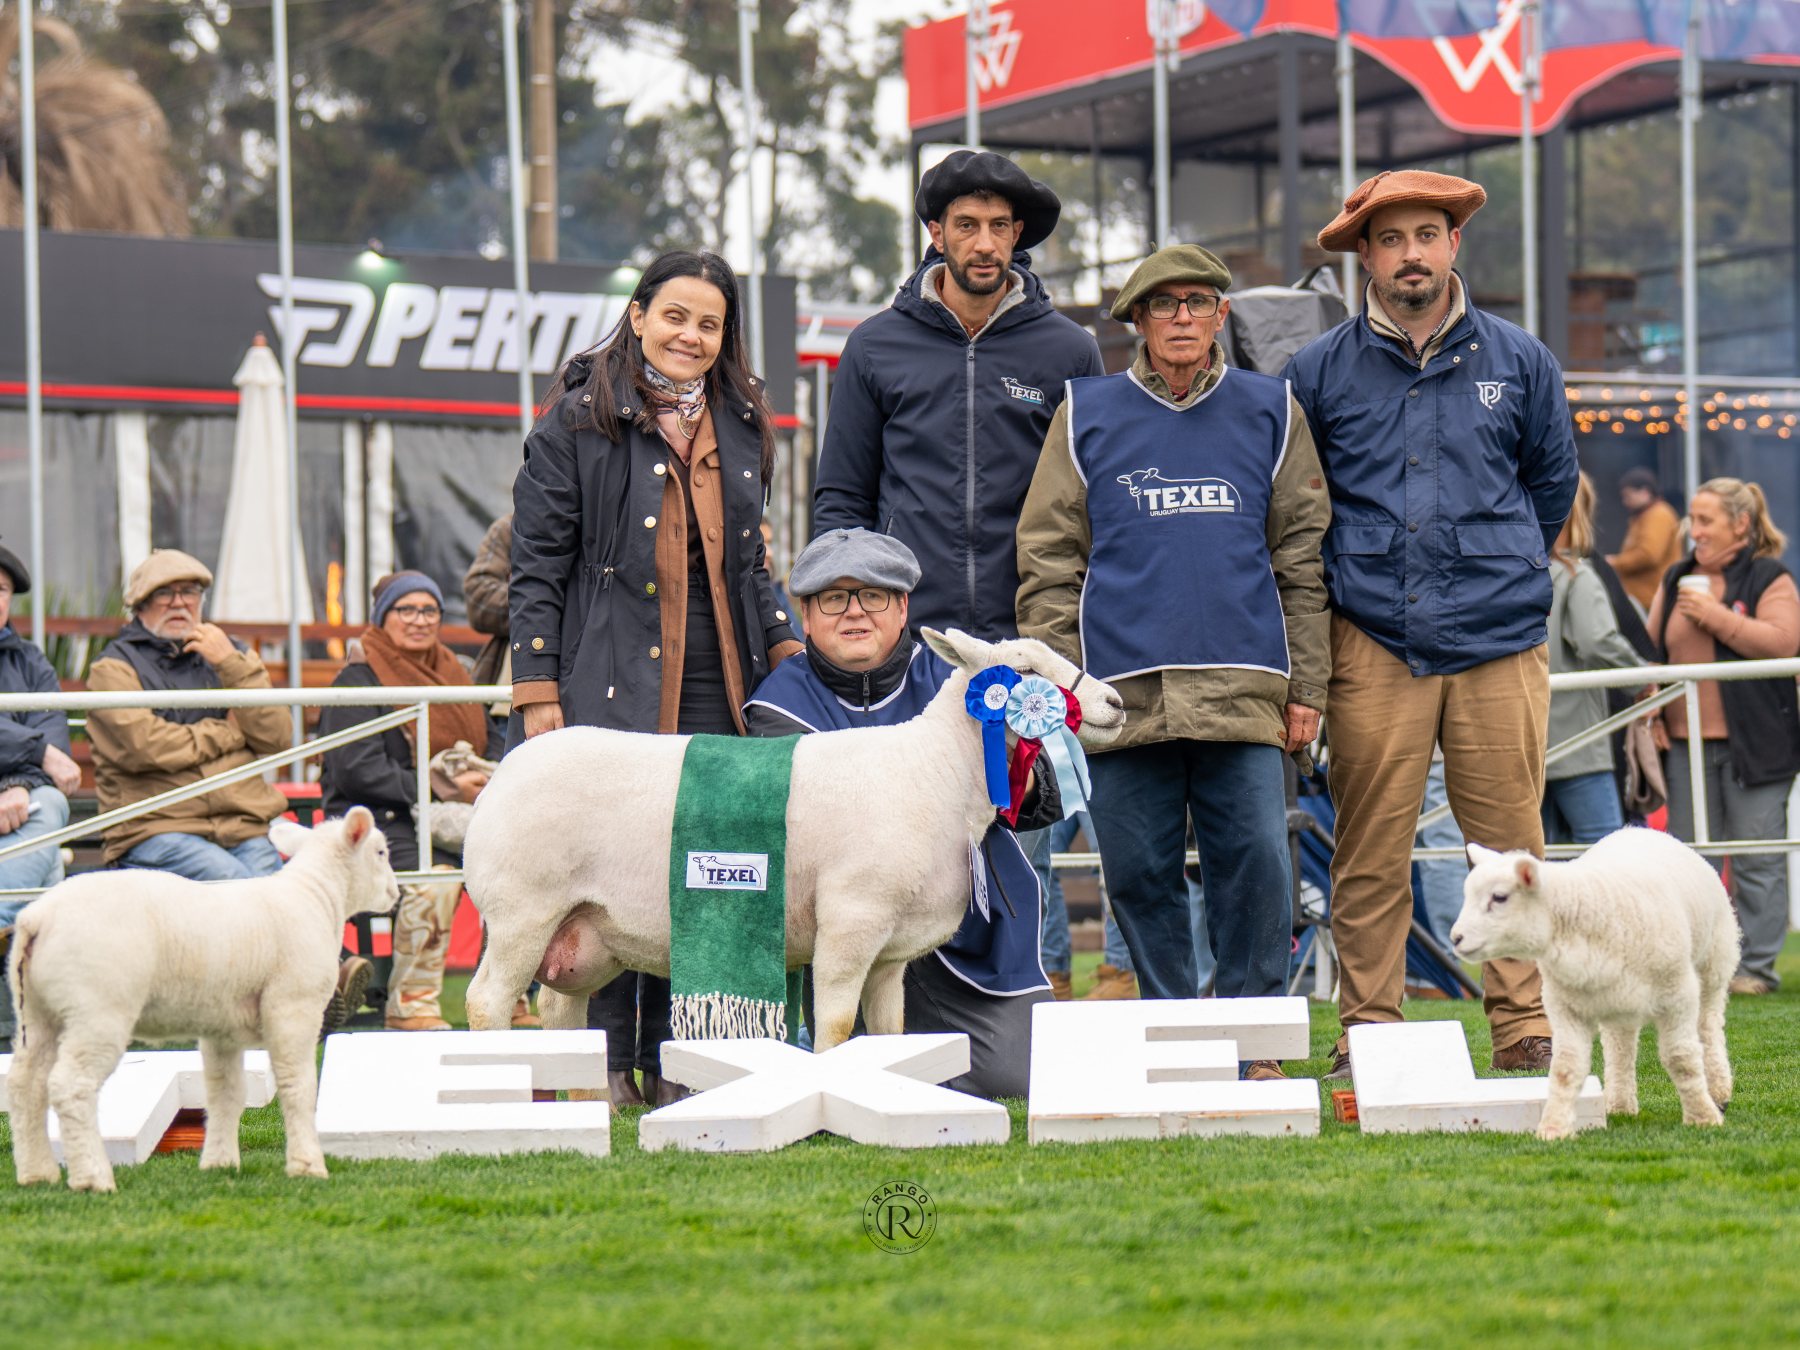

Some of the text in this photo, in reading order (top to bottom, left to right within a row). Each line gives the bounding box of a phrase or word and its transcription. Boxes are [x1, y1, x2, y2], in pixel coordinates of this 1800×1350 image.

[1010, 385, 1042, 402] TEXEL
[1143, 485, 1235, 511] TEXEL
[1150, 508, 1179, 517] URUGUAY
[706, 868, 757, 883] TEXEL
